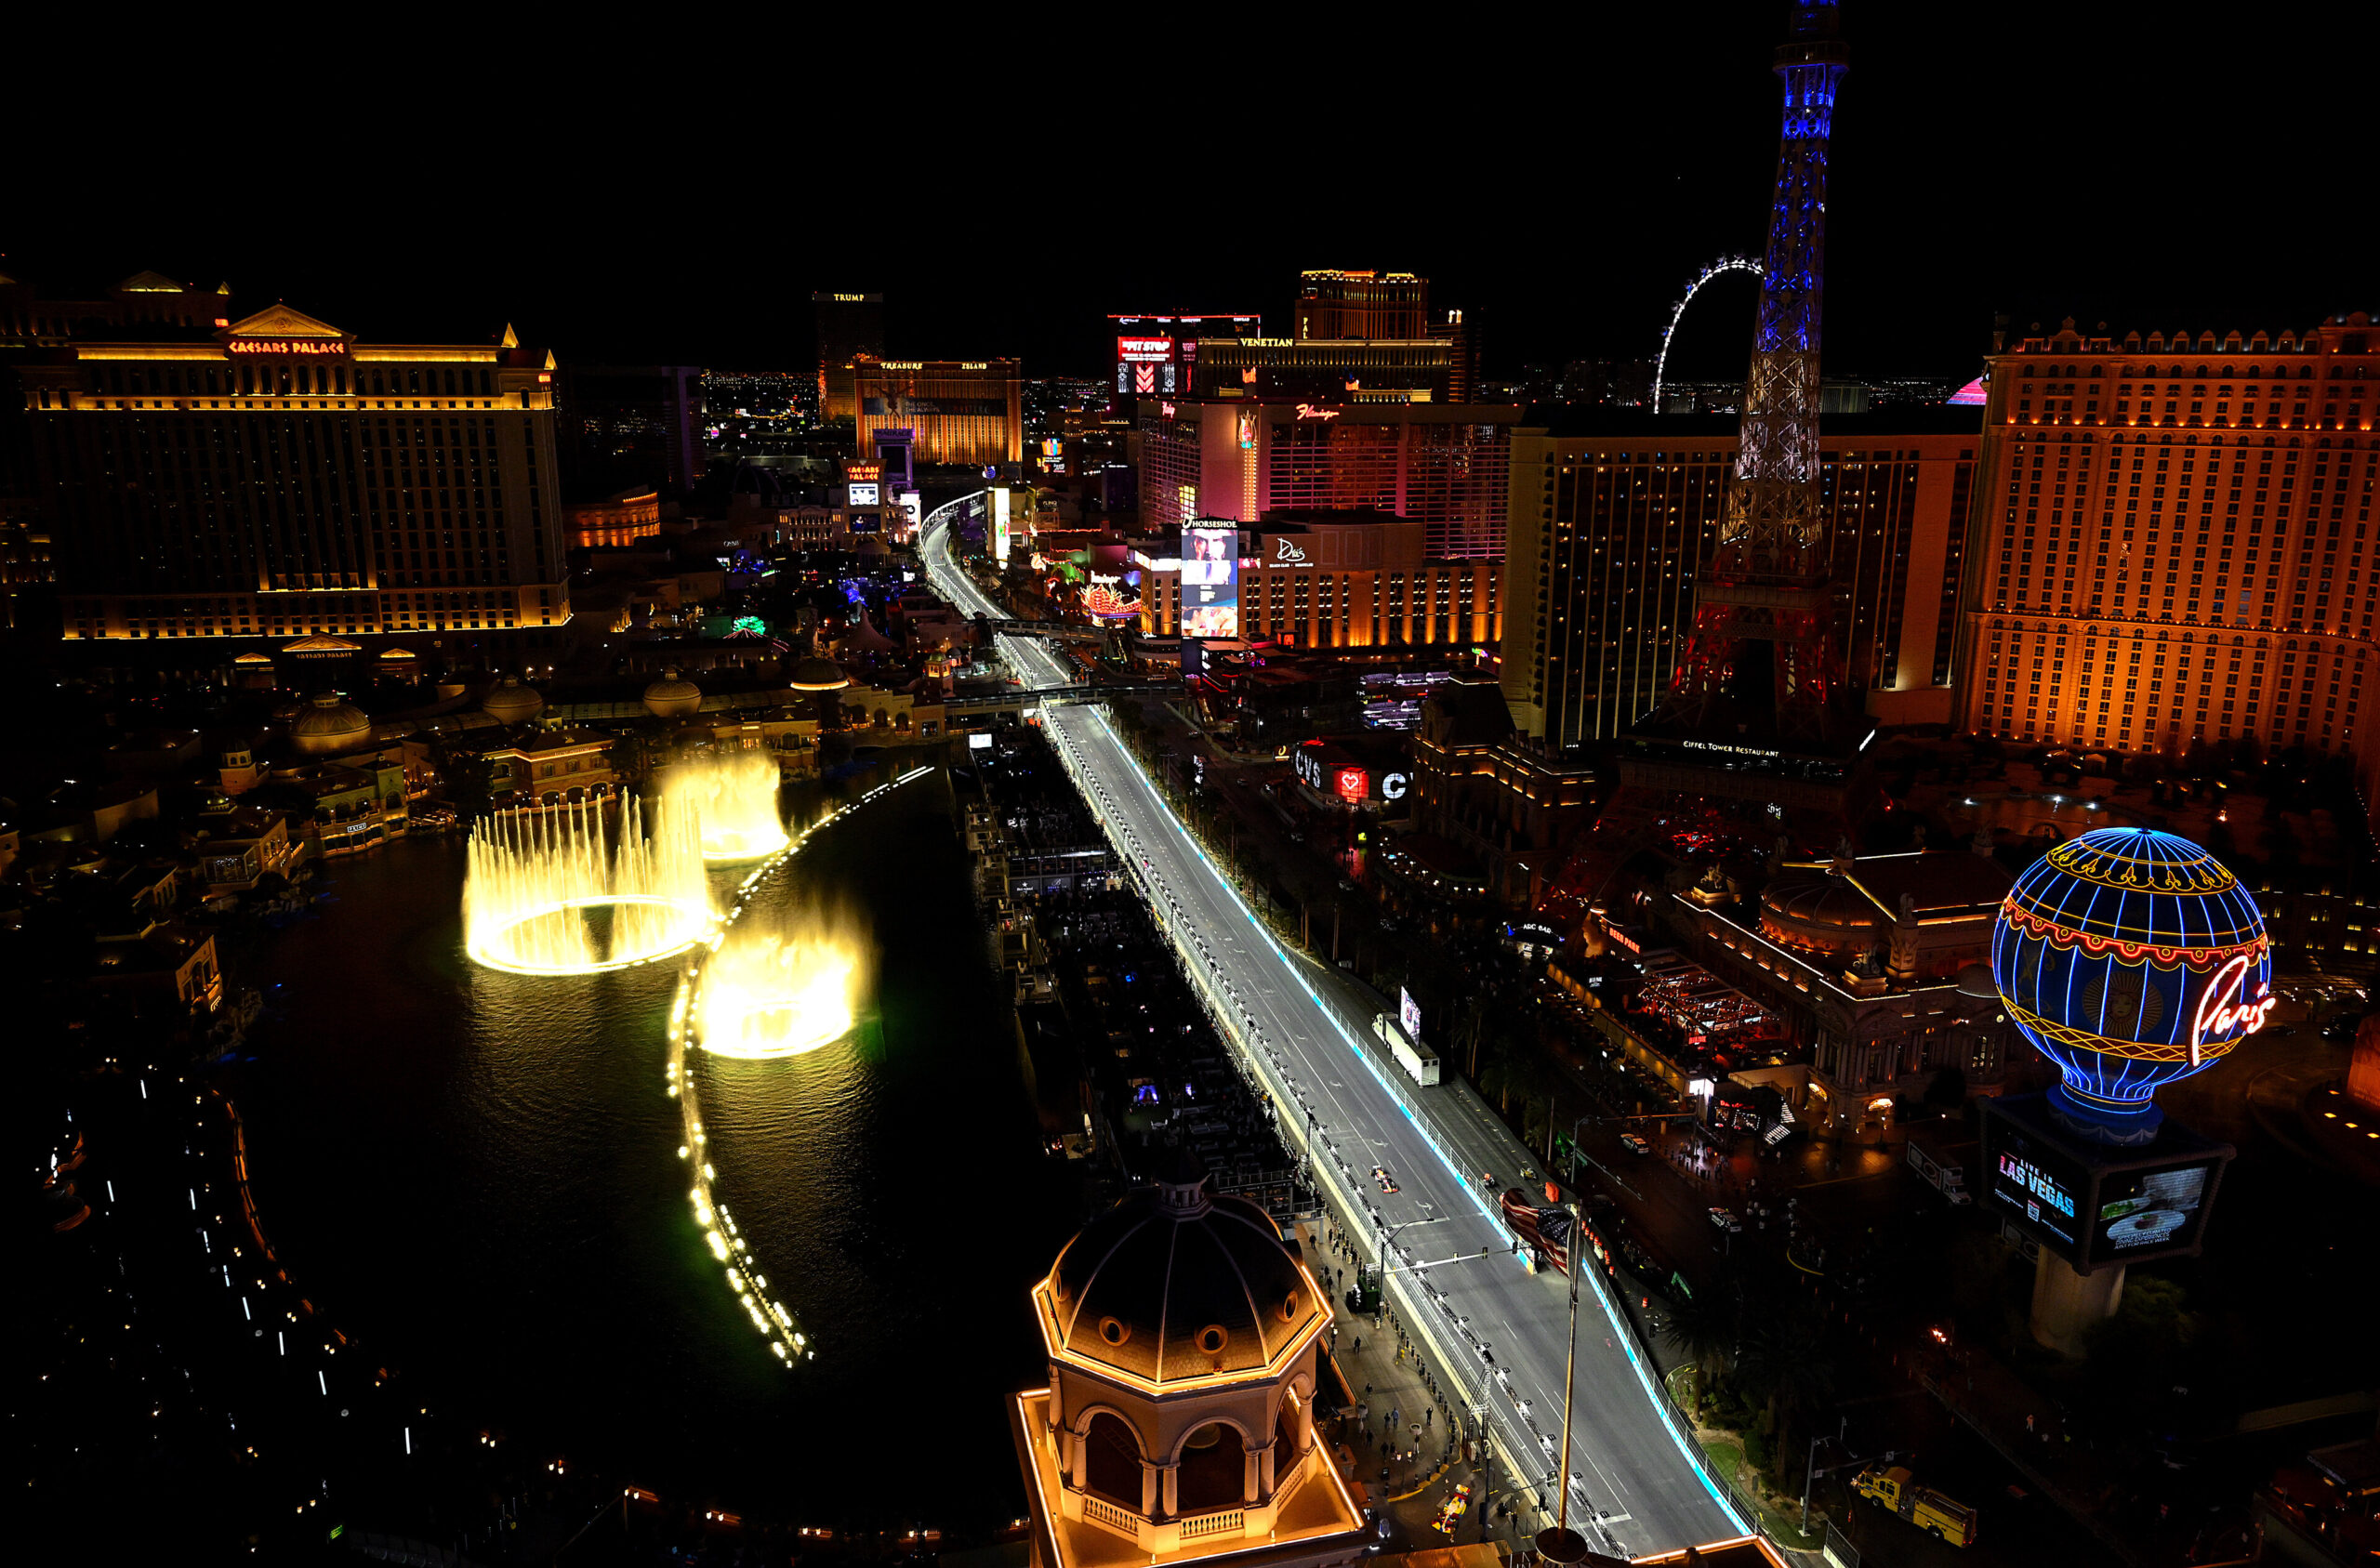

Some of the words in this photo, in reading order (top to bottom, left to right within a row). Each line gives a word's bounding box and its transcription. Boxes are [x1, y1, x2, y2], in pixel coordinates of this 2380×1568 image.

[833, 293, 865, 302] TRUMP
[229, 341, 289, 353] CAESARS
[292, 342, 344, 354] PALACE
[1143, 341, 1170, 350] STOP
[1239, 337, 1293, 347] VENETIAN
[1296, 403, 1340, 421] Flamingo
[1683, 741, 1707, 749] EIFFEL
[1708, 743, 1733, 753] TOWER
[1735, 746, 1779, 758] RESTAURANT
[1295, 749, 1321, 788] CVS
[1382, 772, 1414, 799] C
[1609, 927, 1624, 944] BEER
[1624, 937, 1641, 955] PARK
[2191, 955, 2277, 1067] Paris
[2020, 1158, 2039, 1176] LIVE
[2043, 1173, 2053, 1184] IN
[1999, 1154, 2026, 1186] LAS
[2028, 1171, 2075, 1219] VEGAS
